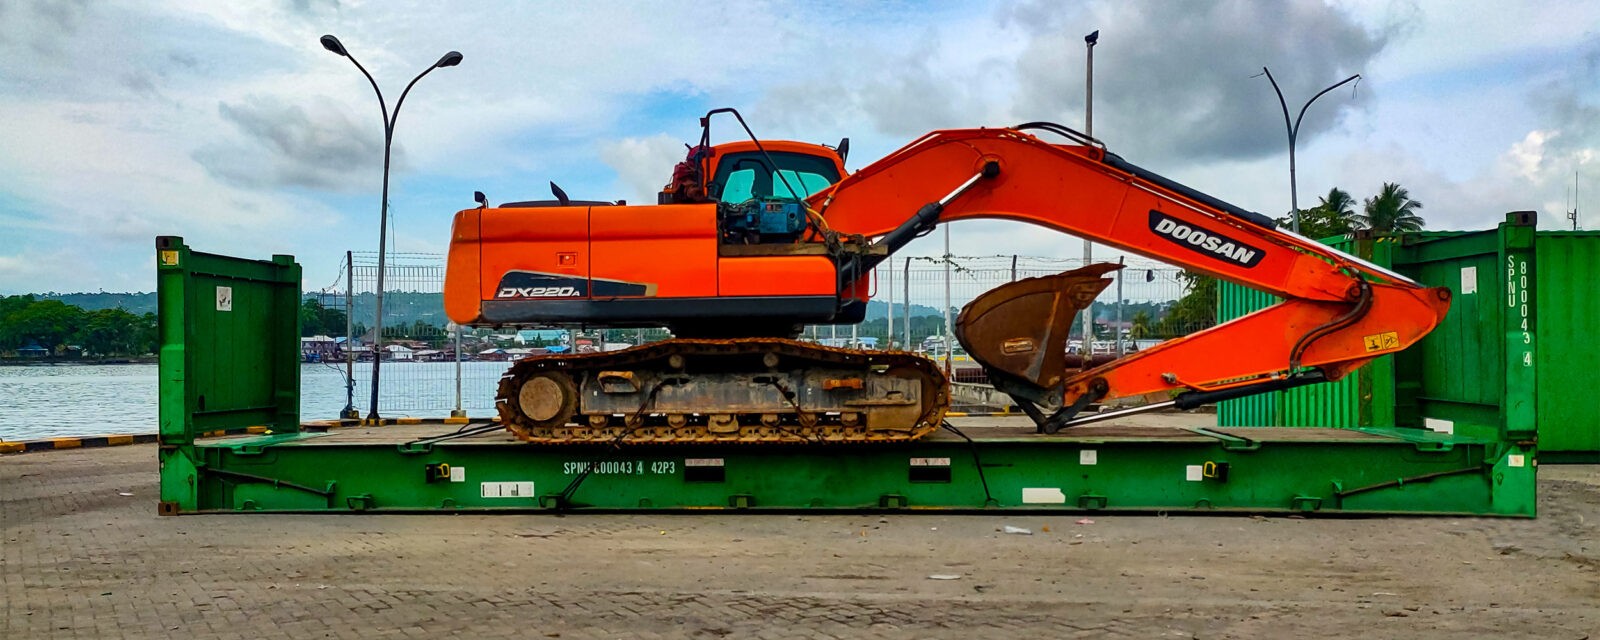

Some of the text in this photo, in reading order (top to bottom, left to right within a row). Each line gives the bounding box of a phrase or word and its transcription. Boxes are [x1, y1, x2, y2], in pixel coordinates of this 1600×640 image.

[1155, 218, 1255, 264] DOOSAN
[1508, 255, 1516, 308] SPNU
[1520, 261, 1532, 366] 800043 4
[637, 461, 643, 474] 4
[651, 461, 675, 474] 42P3
